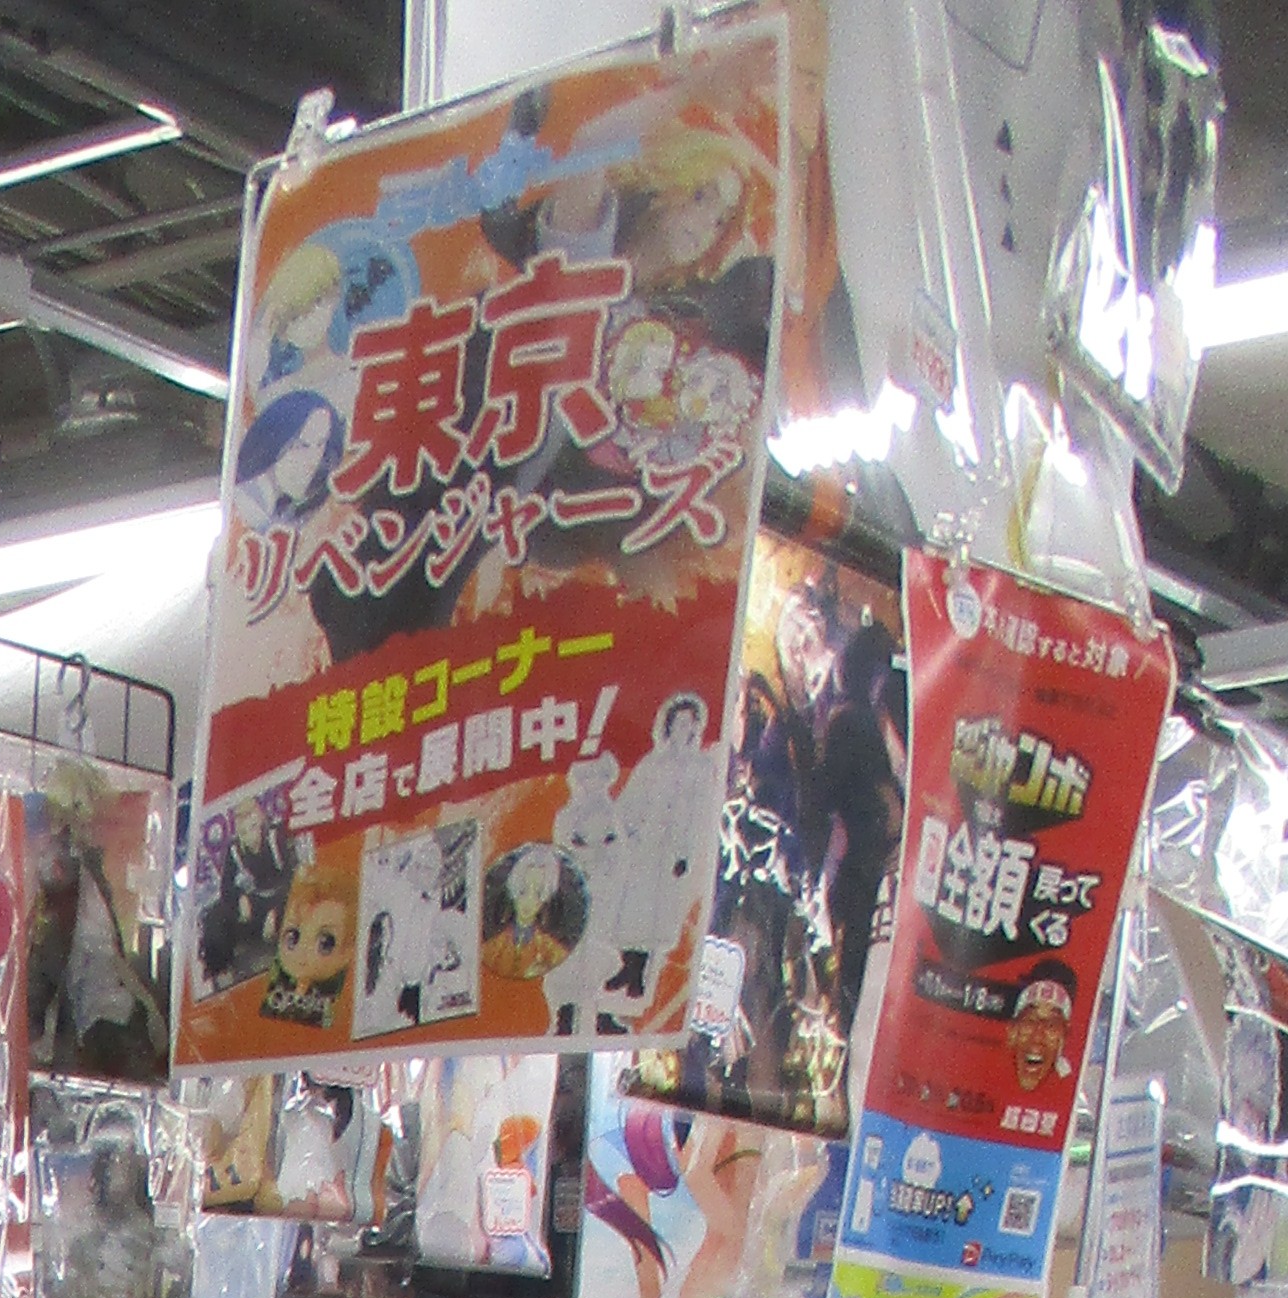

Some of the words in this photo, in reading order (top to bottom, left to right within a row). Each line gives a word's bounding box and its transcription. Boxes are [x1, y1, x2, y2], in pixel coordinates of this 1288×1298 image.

[331, 253, 636, 505] 東京
[238, 440, 750, 624] リベンジャーズ
[286, 683, 622, 835] 全店で展開中!
[308, 624, 616, 756] 特設コーナー
[1029, 909, 1070, 948] くる
[1033, 863, 1103, 910] 戻って
